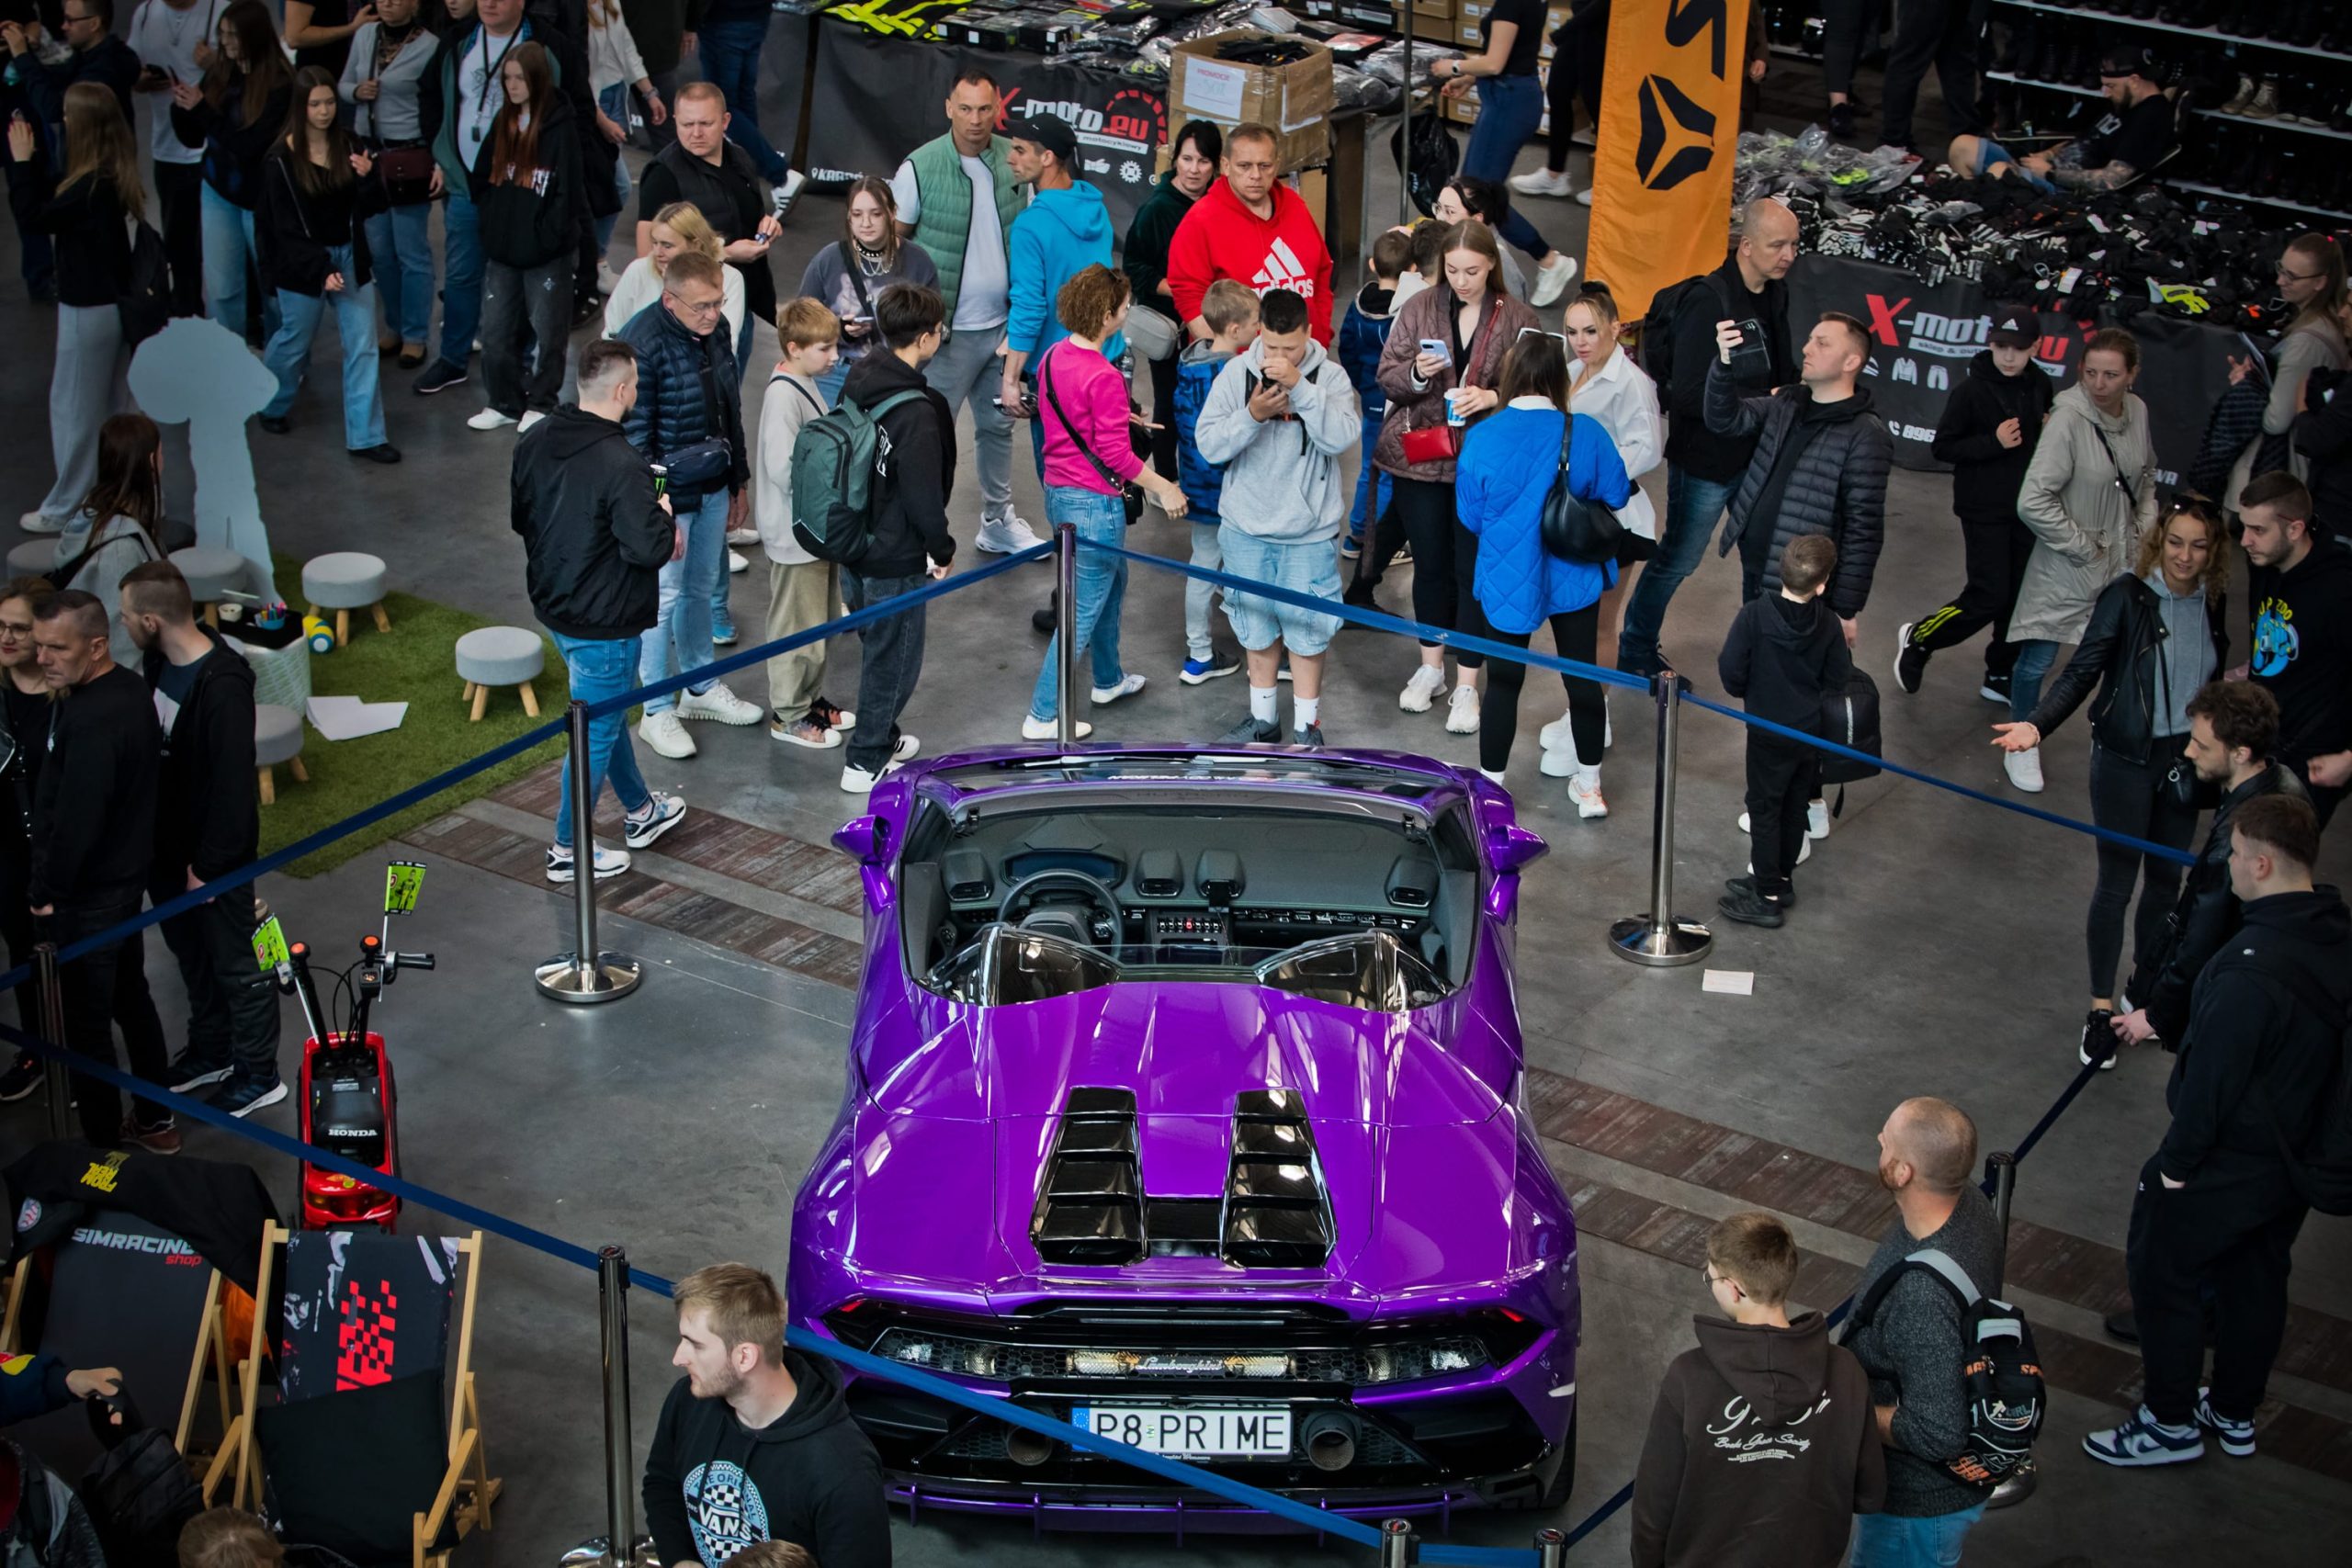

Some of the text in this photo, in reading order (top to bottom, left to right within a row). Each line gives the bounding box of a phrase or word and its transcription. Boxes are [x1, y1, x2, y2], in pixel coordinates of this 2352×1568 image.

[328, 1129, 378, 1137] HONDA
[165, 1254, 202, 1267] shop
[1136, 1357, 1223, 1373] Lamborghini
[1097, 1414, 1284, 1450] P8 PRIME
[699, 1503, 752, 1541] VANS
